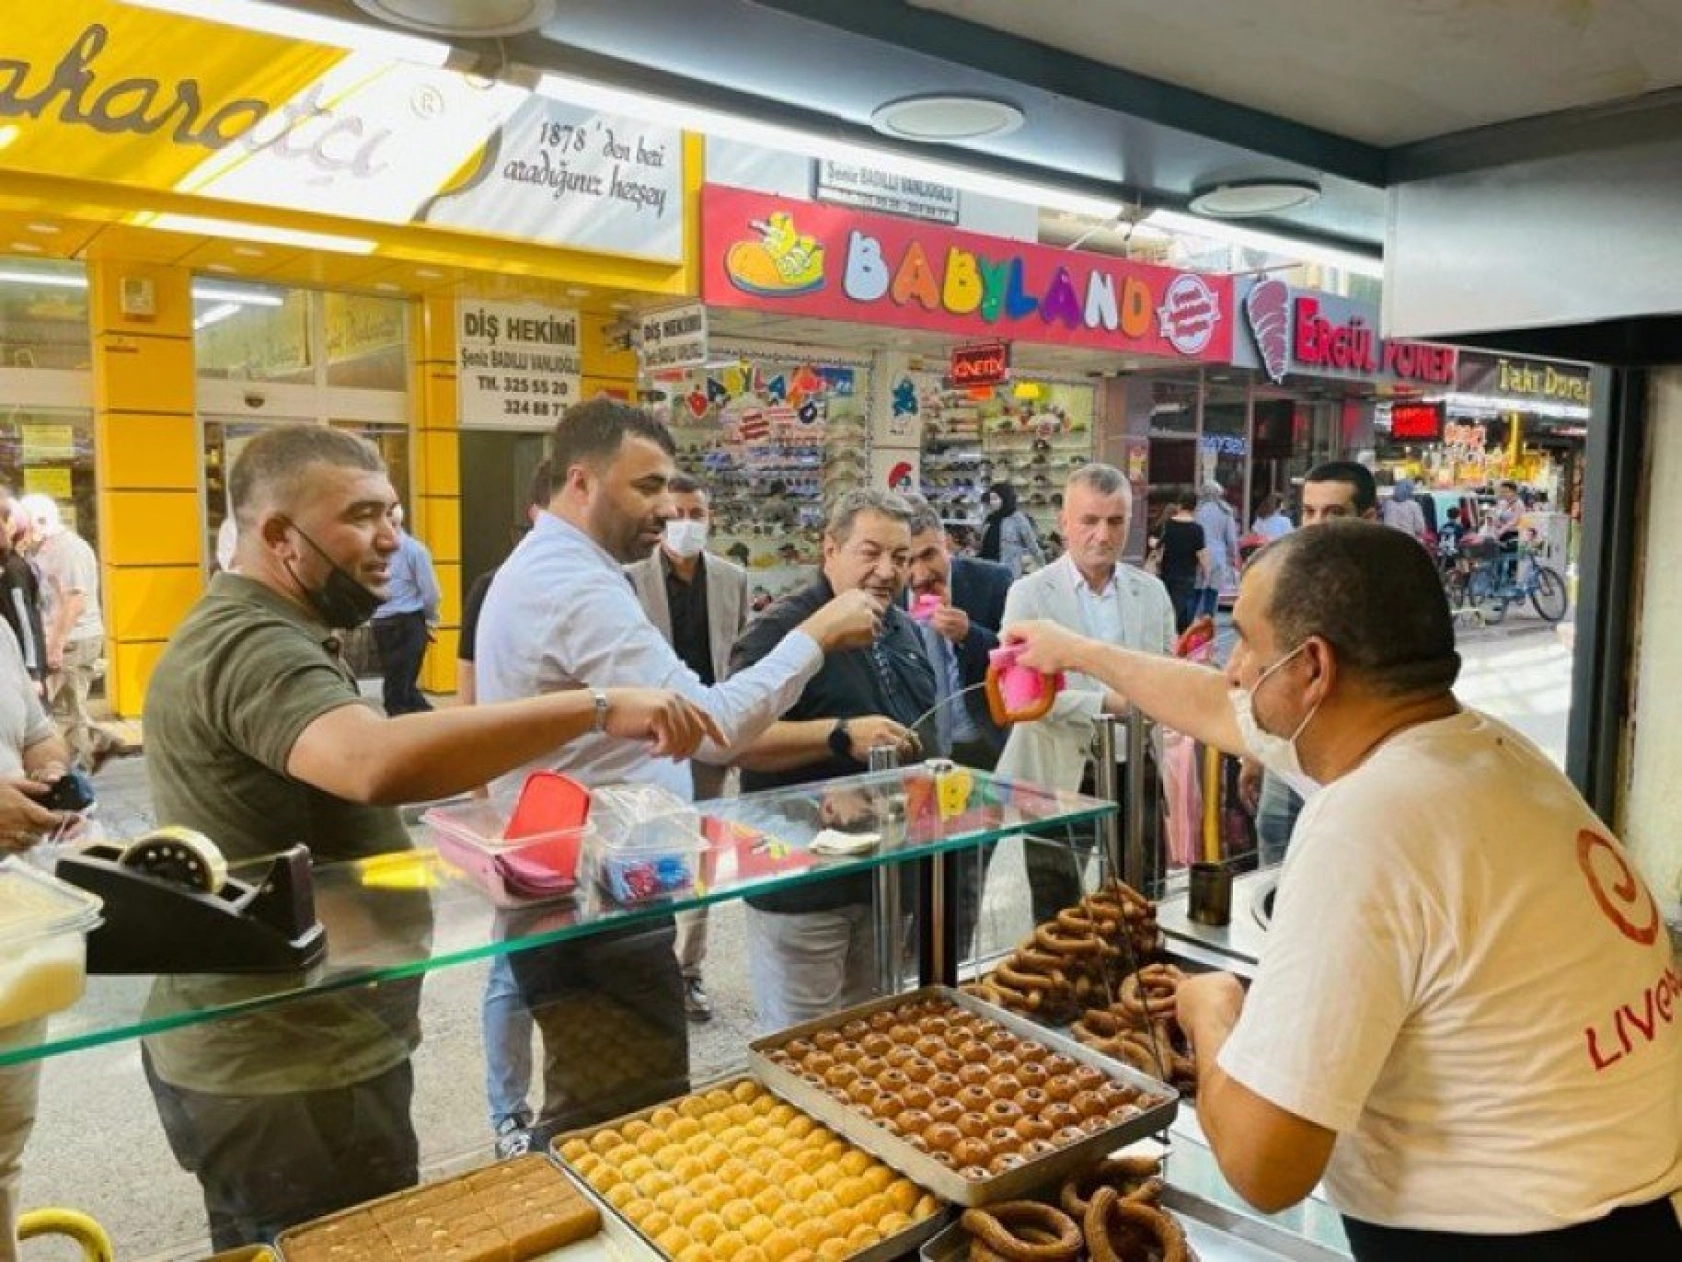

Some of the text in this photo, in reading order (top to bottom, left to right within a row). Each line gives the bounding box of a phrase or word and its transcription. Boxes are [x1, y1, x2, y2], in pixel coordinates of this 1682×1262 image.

[541, 123, 587, 153] 1878
[636, 136, 666, 166] beri
[608, 164, 667, 218] herşey
[843, 230, 1150, 337] BABYLAND
[464, 307, 576, 346] DİŞ HEKİMİ
[503, 376, 529, 392] 325
[503, 399, 529, 415] 324
